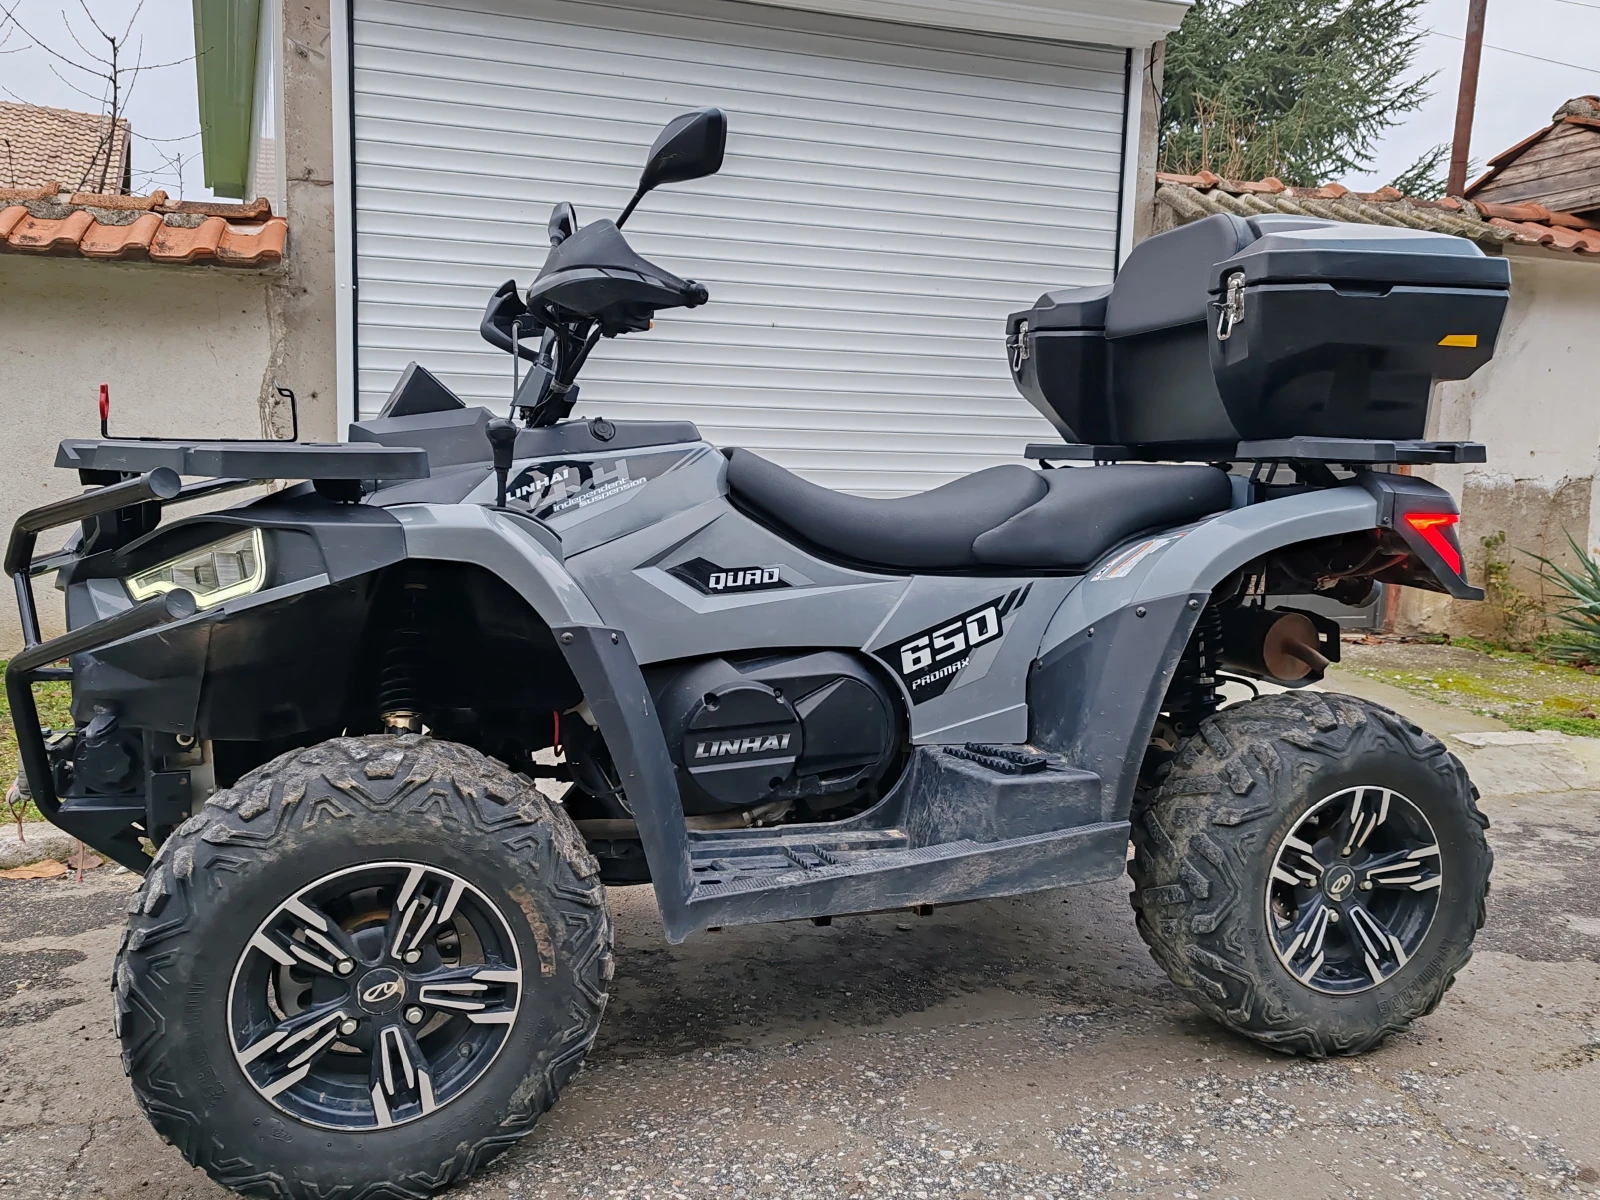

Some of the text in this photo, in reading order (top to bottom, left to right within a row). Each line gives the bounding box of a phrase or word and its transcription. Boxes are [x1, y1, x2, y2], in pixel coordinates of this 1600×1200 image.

[506, 469, 569, 502] LINHAI
[553, 476, 630, 513] independent
[578, 476, 648, 509] suspension
[708, 567, 780, 590] QUAD
[900, 606, 999, 675] 650
[912, 656, 971, 691] PROMAX
[694, 733, 791, 759] LINHAI
